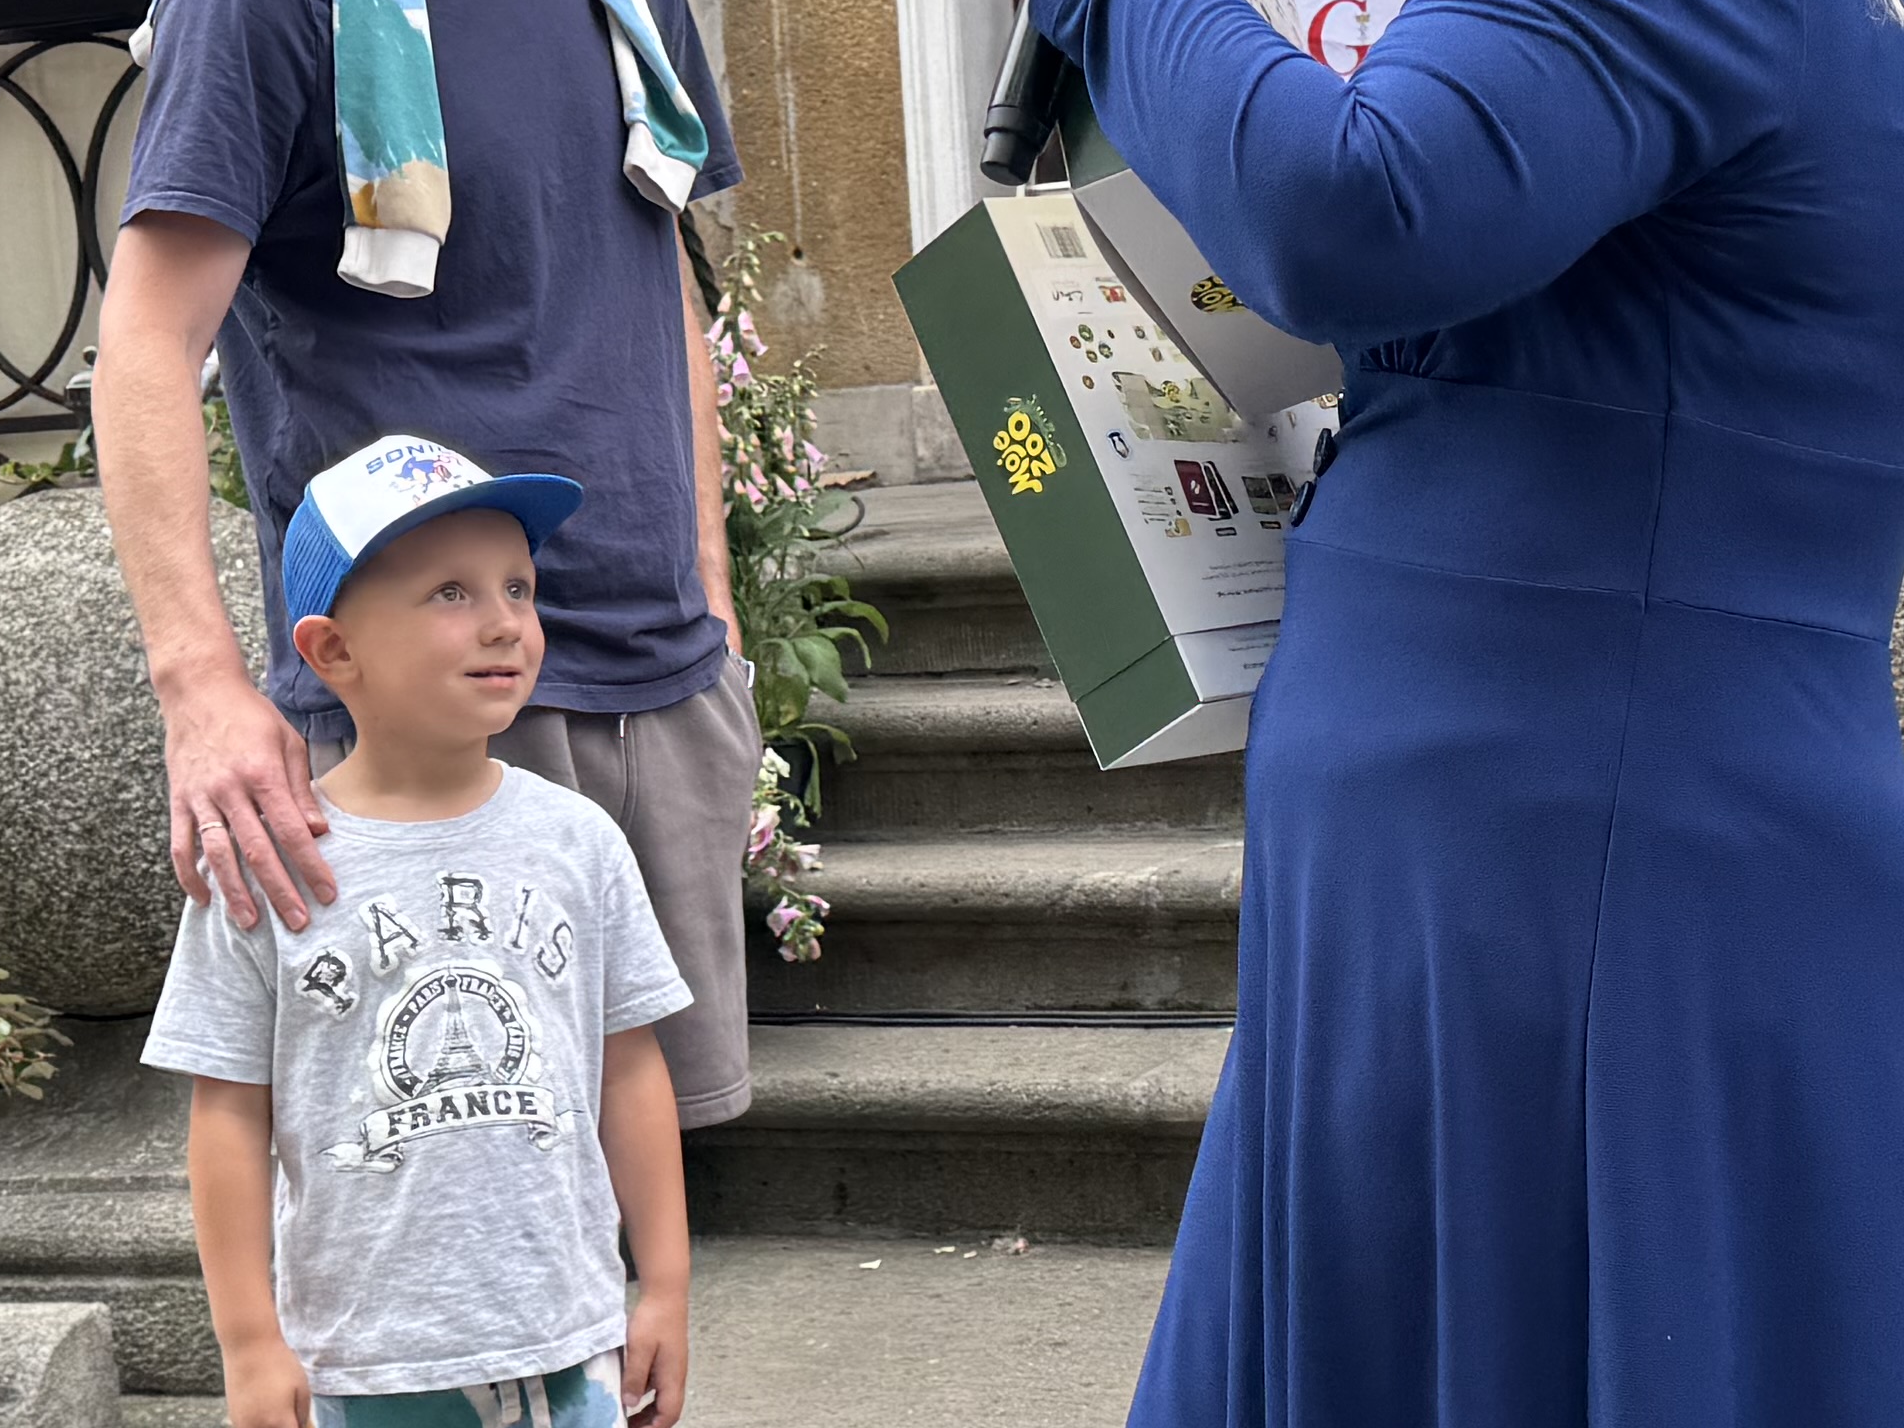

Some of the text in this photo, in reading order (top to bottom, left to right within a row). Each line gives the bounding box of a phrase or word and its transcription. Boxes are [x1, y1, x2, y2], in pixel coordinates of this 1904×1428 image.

[366, 444, 442, 475] SONI
[299, 872, 574, 1015] PARIS
[386, 1089, 539, 1138] FRANCE
